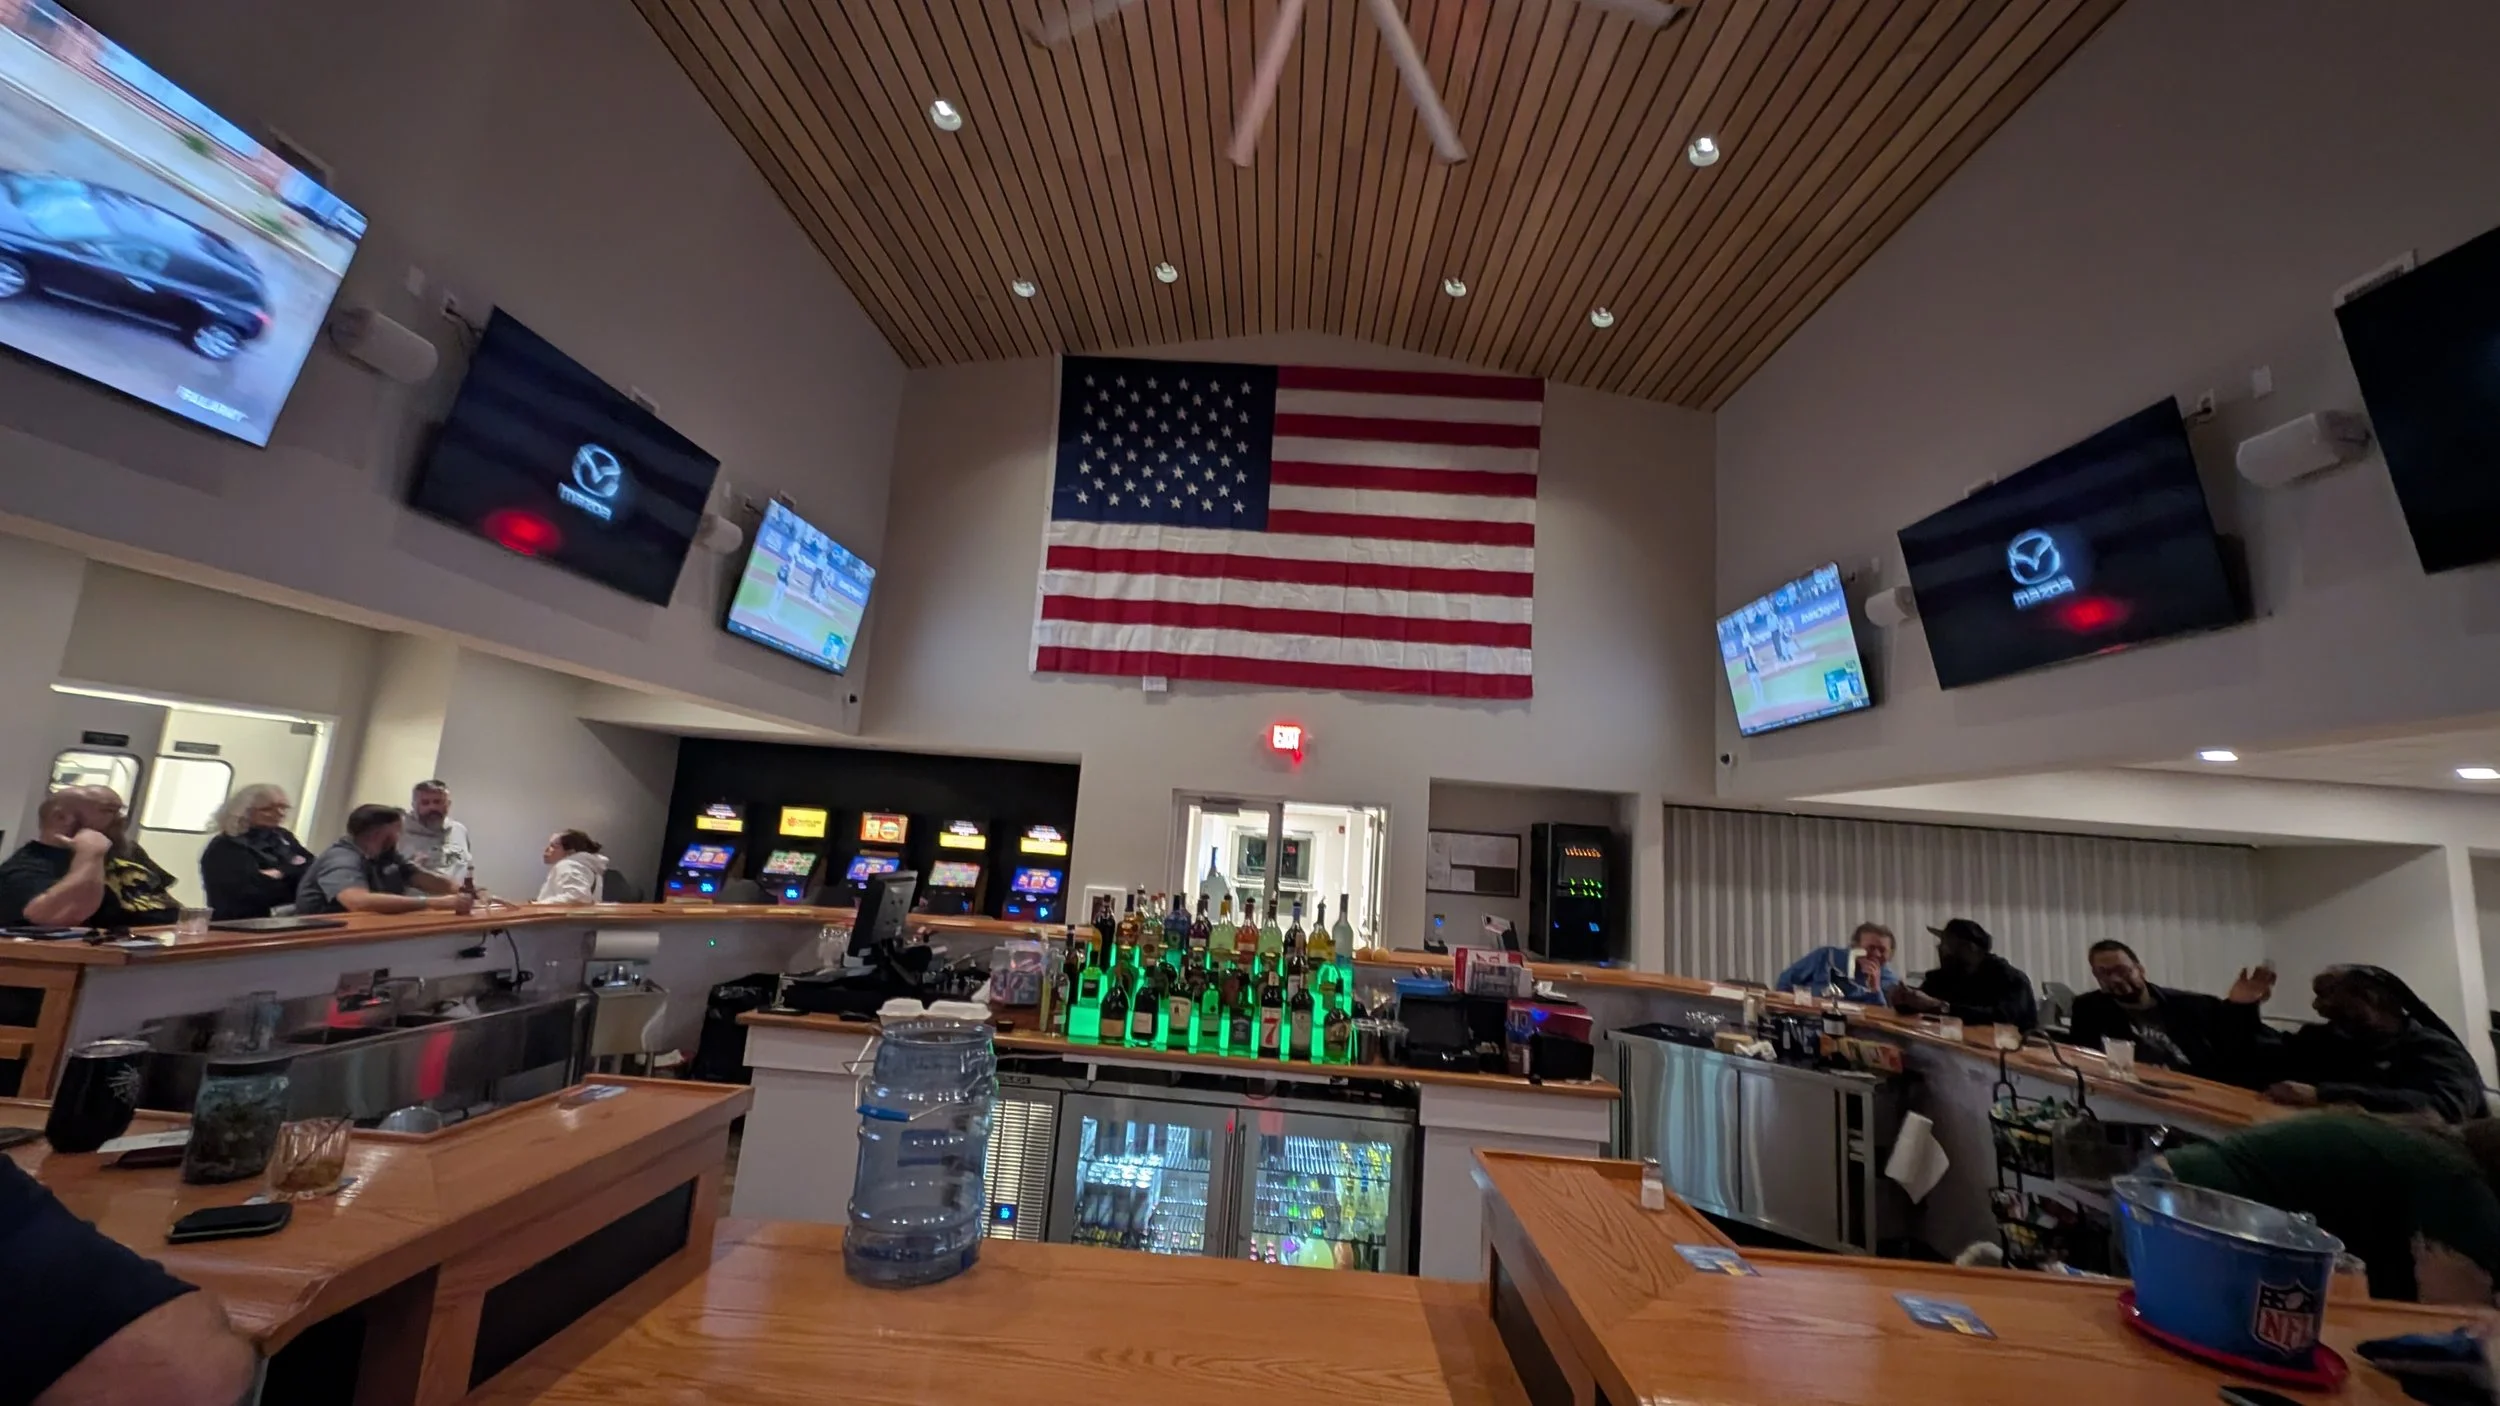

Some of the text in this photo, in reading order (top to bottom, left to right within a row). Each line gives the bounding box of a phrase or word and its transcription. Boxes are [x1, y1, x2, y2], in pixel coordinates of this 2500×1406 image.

[558, 482, 612, 520] mazda
[2012, 576, 2075, 609] mazda
[1262, 1016, 1280, 1046] 7
